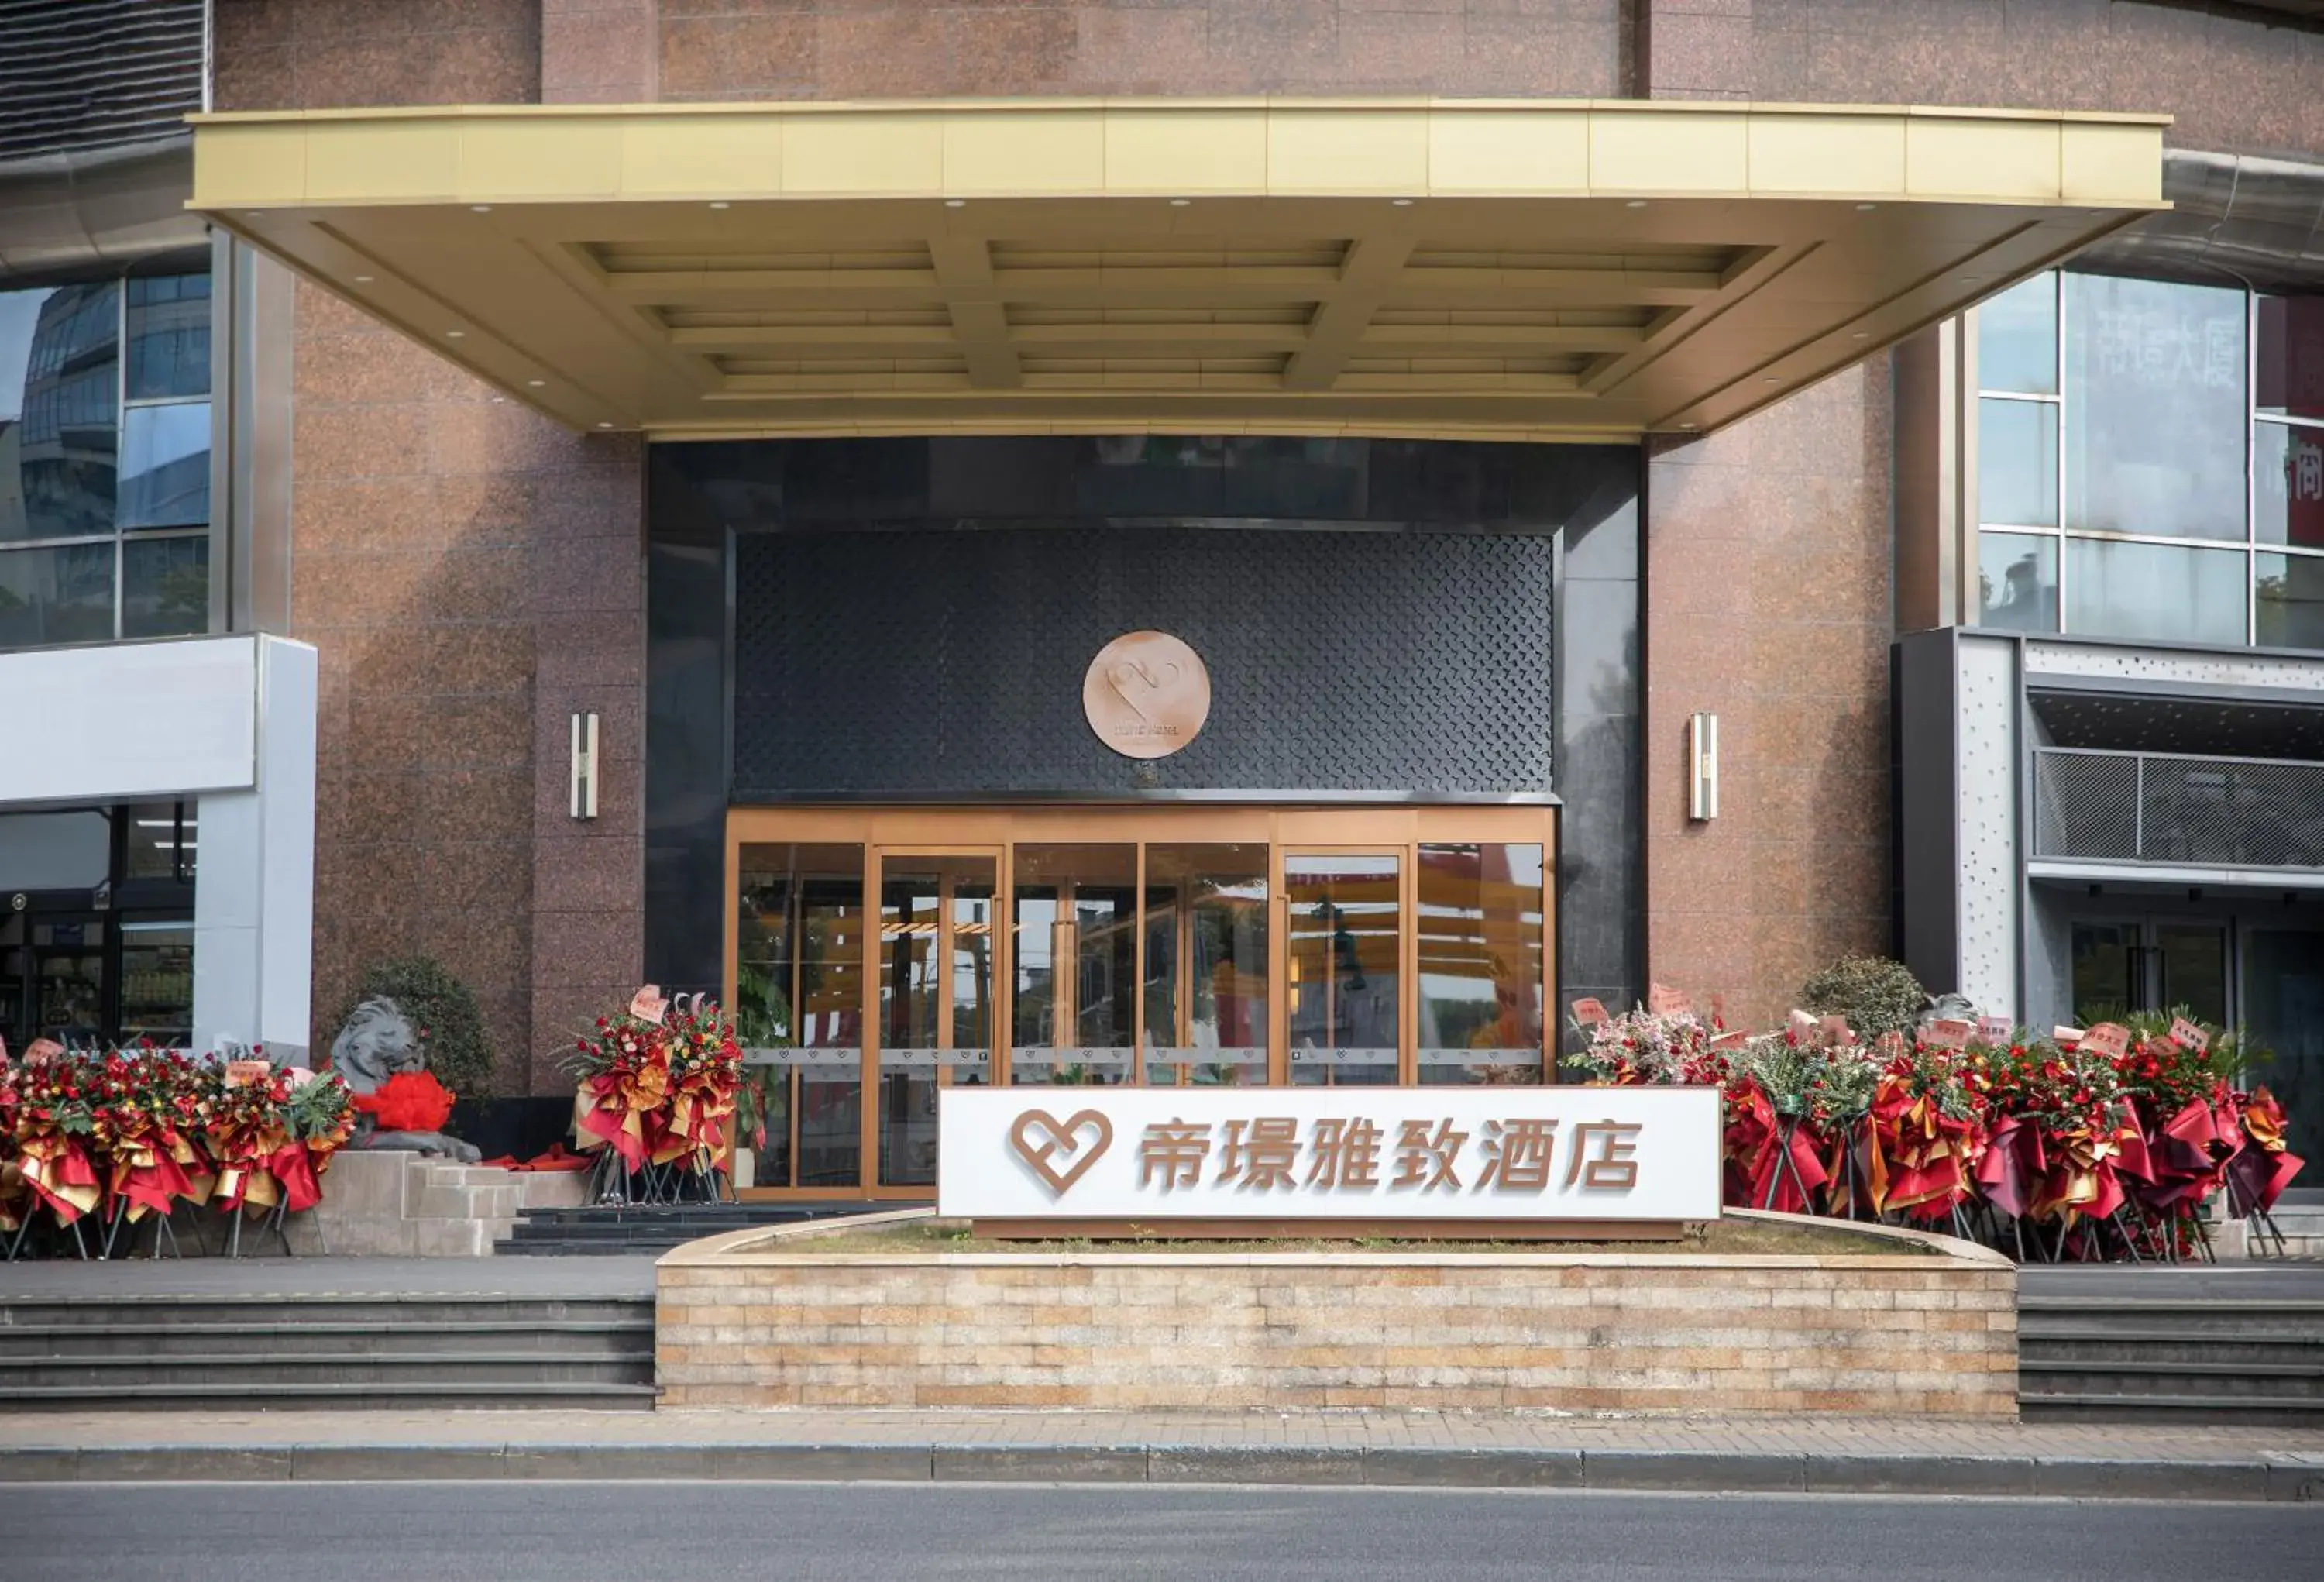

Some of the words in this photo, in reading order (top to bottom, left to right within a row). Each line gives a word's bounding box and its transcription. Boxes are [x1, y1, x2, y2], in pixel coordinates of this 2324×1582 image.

[1140, 1117, 1644, 1191] 帝璟雅致酒店
